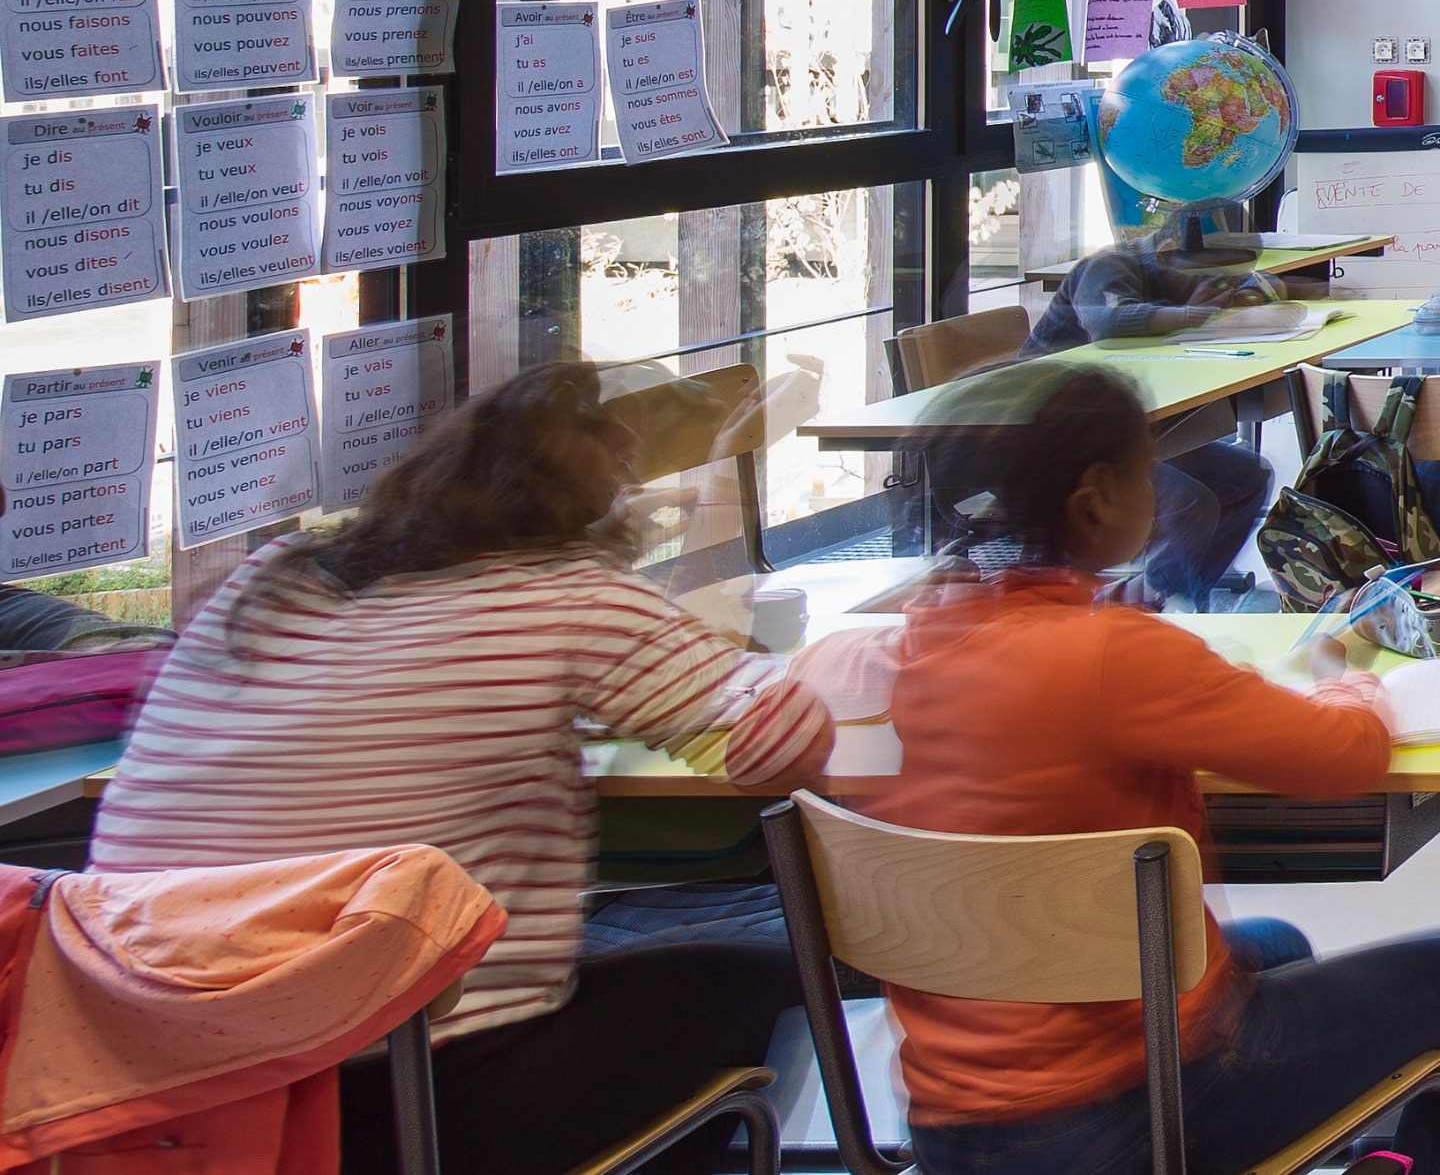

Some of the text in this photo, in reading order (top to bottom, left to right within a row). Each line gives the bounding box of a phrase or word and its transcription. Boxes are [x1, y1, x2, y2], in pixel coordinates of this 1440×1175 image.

[19, 14, 130, 32] nous faisons
[193, 9, 297, 25] nous pouvons
[515, 12, 543, 22] Avoir
[626, 11, 645, 22] Être
[194, 36, 289, 52] vous pouvez
[515, 35, 533, 48] j'ai
[22, 42, 119, 61] vous faites
[194, 60, 300, 80] ils/elles peuvent
[517, 59, 546, 68] tu as
[24, 69, 128, 90] ils/elles font
[518, 80, 583, 93] il /elle/on a
[349, 101, 373, 112] Voir
[516, 102, 580, 114] nous avons
[192, 113, 240, 127] Vouloir
[34, 123, 68, 137] Dire
[514, 125, 570, 138] vous avez
[513, 146, 578, 162] ils/elles ont
[1403, 182, 1425, 196] DE
[1388, 235, 1408, 252] la
[349, 337, 379, 350] Aller
[199, 355, 236, 371] Venir
[27, 380, 71, 395] Partir
